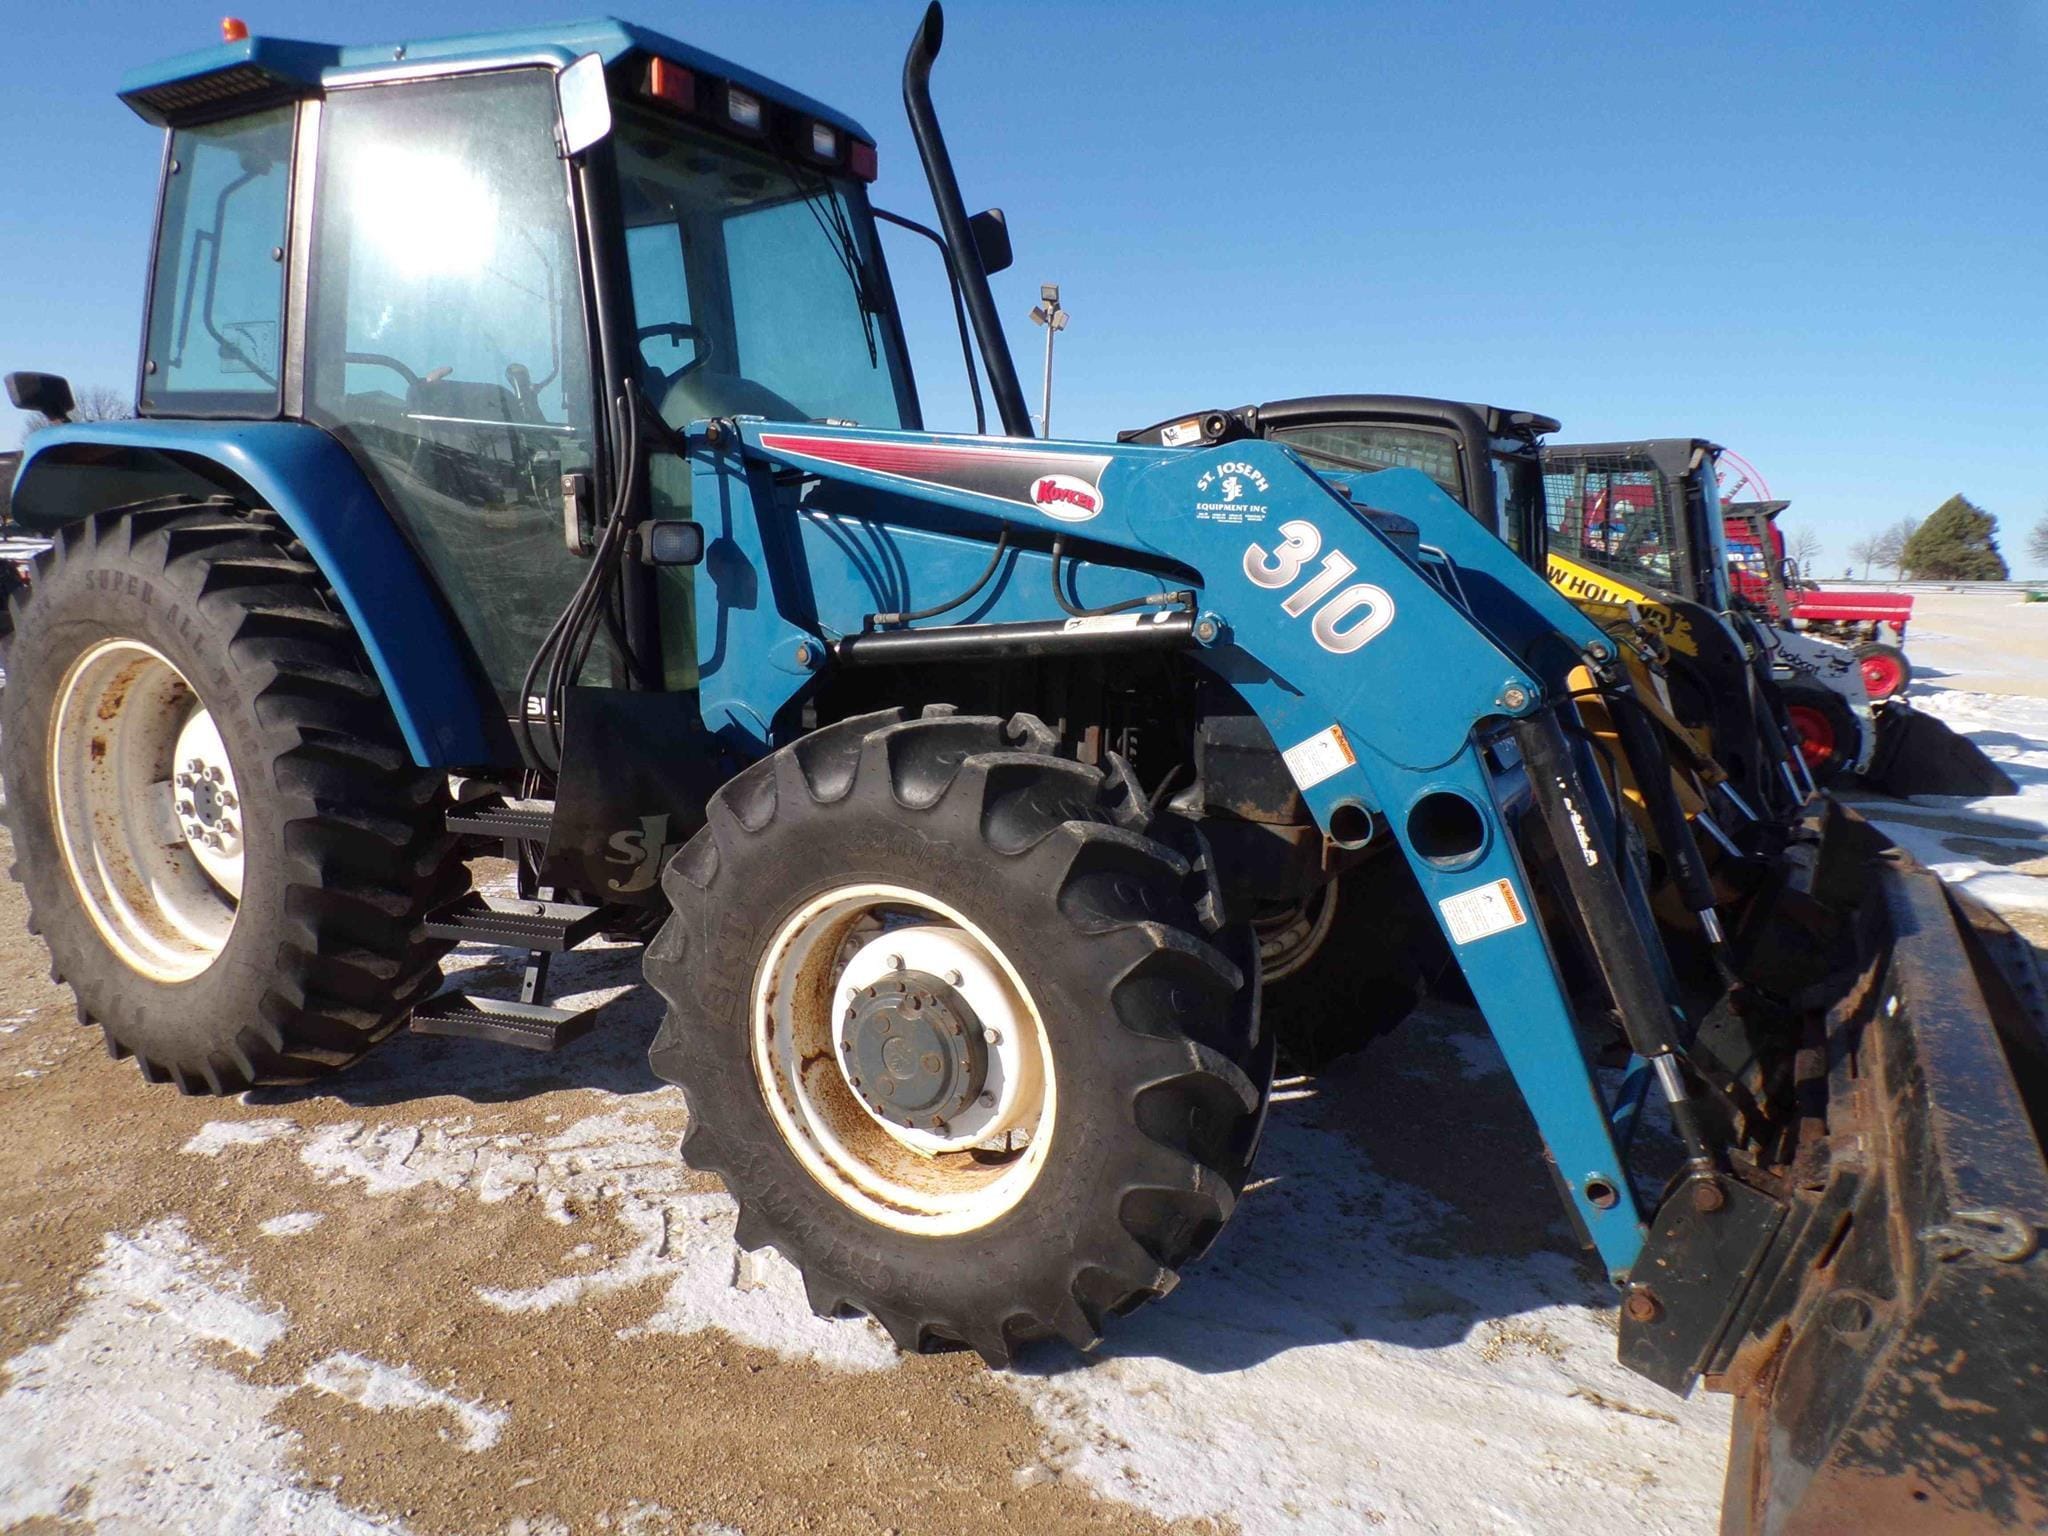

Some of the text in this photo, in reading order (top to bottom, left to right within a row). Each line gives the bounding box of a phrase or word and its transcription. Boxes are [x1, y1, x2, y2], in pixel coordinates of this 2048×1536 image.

[1197, 461, 1270, 493] ST. JOSEPH
[1196, 502, 1269, 515] EQUIPMENT INC
[85, 568, 154, 606] SUPER
[1243, 519, 1395, 655] 310
